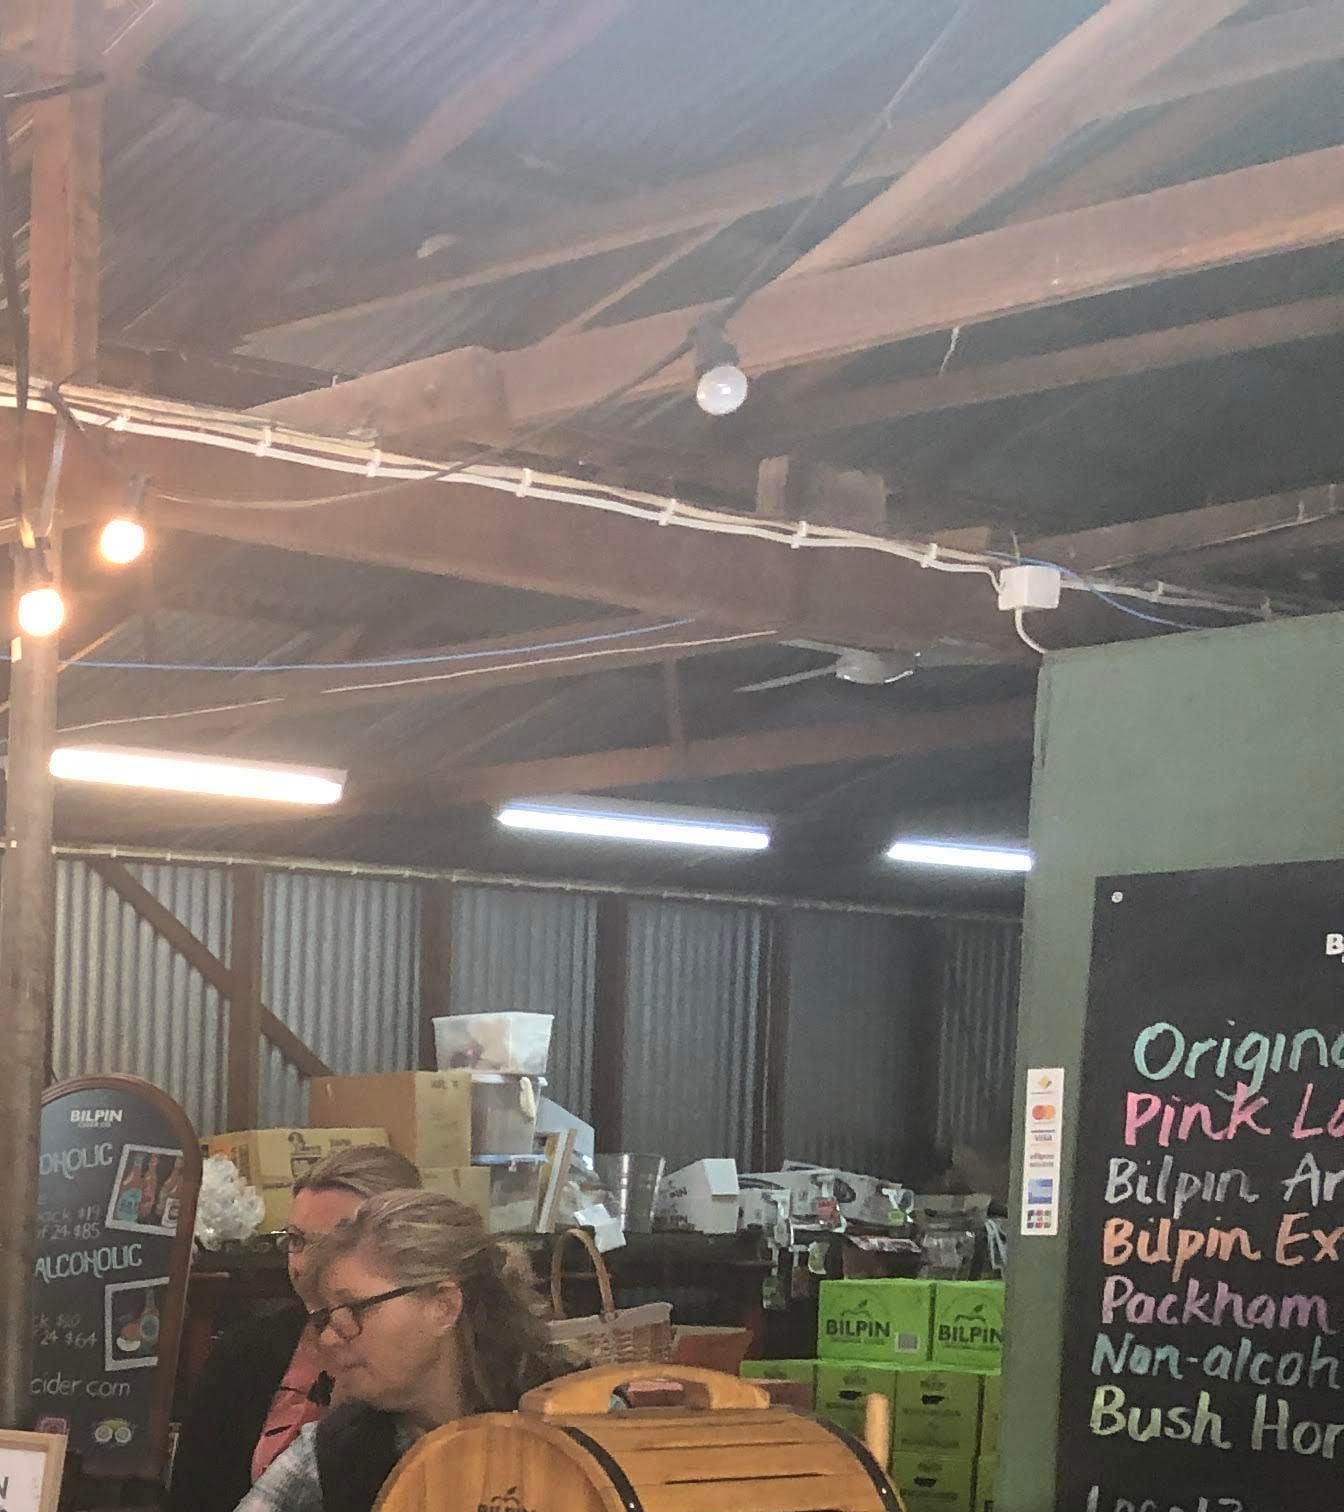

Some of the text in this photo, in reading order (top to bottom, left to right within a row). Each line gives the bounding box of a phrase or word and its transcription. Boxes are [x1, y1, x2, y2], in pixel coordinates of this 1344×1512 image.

[70, 1109, 123, 1122] BILPIN
[1124, 1081, 1270, 1147] Pink
[1104, 1155, 1260, 1220] Bilpin
[72, 1222, 101, 1240] $85
[1102, 1212, 1344, 1283] Bilpin Ex
[34, 1243, 142, 1284] ALCOHOLIC
[826, 1318, 890, 1337] BILPIN
[1101, 1274, 1337, 1335] Packham
[1091, 1332, 1341, 1390] Non-alcoh
[1090, 1384, 1232, 1449] Bush
